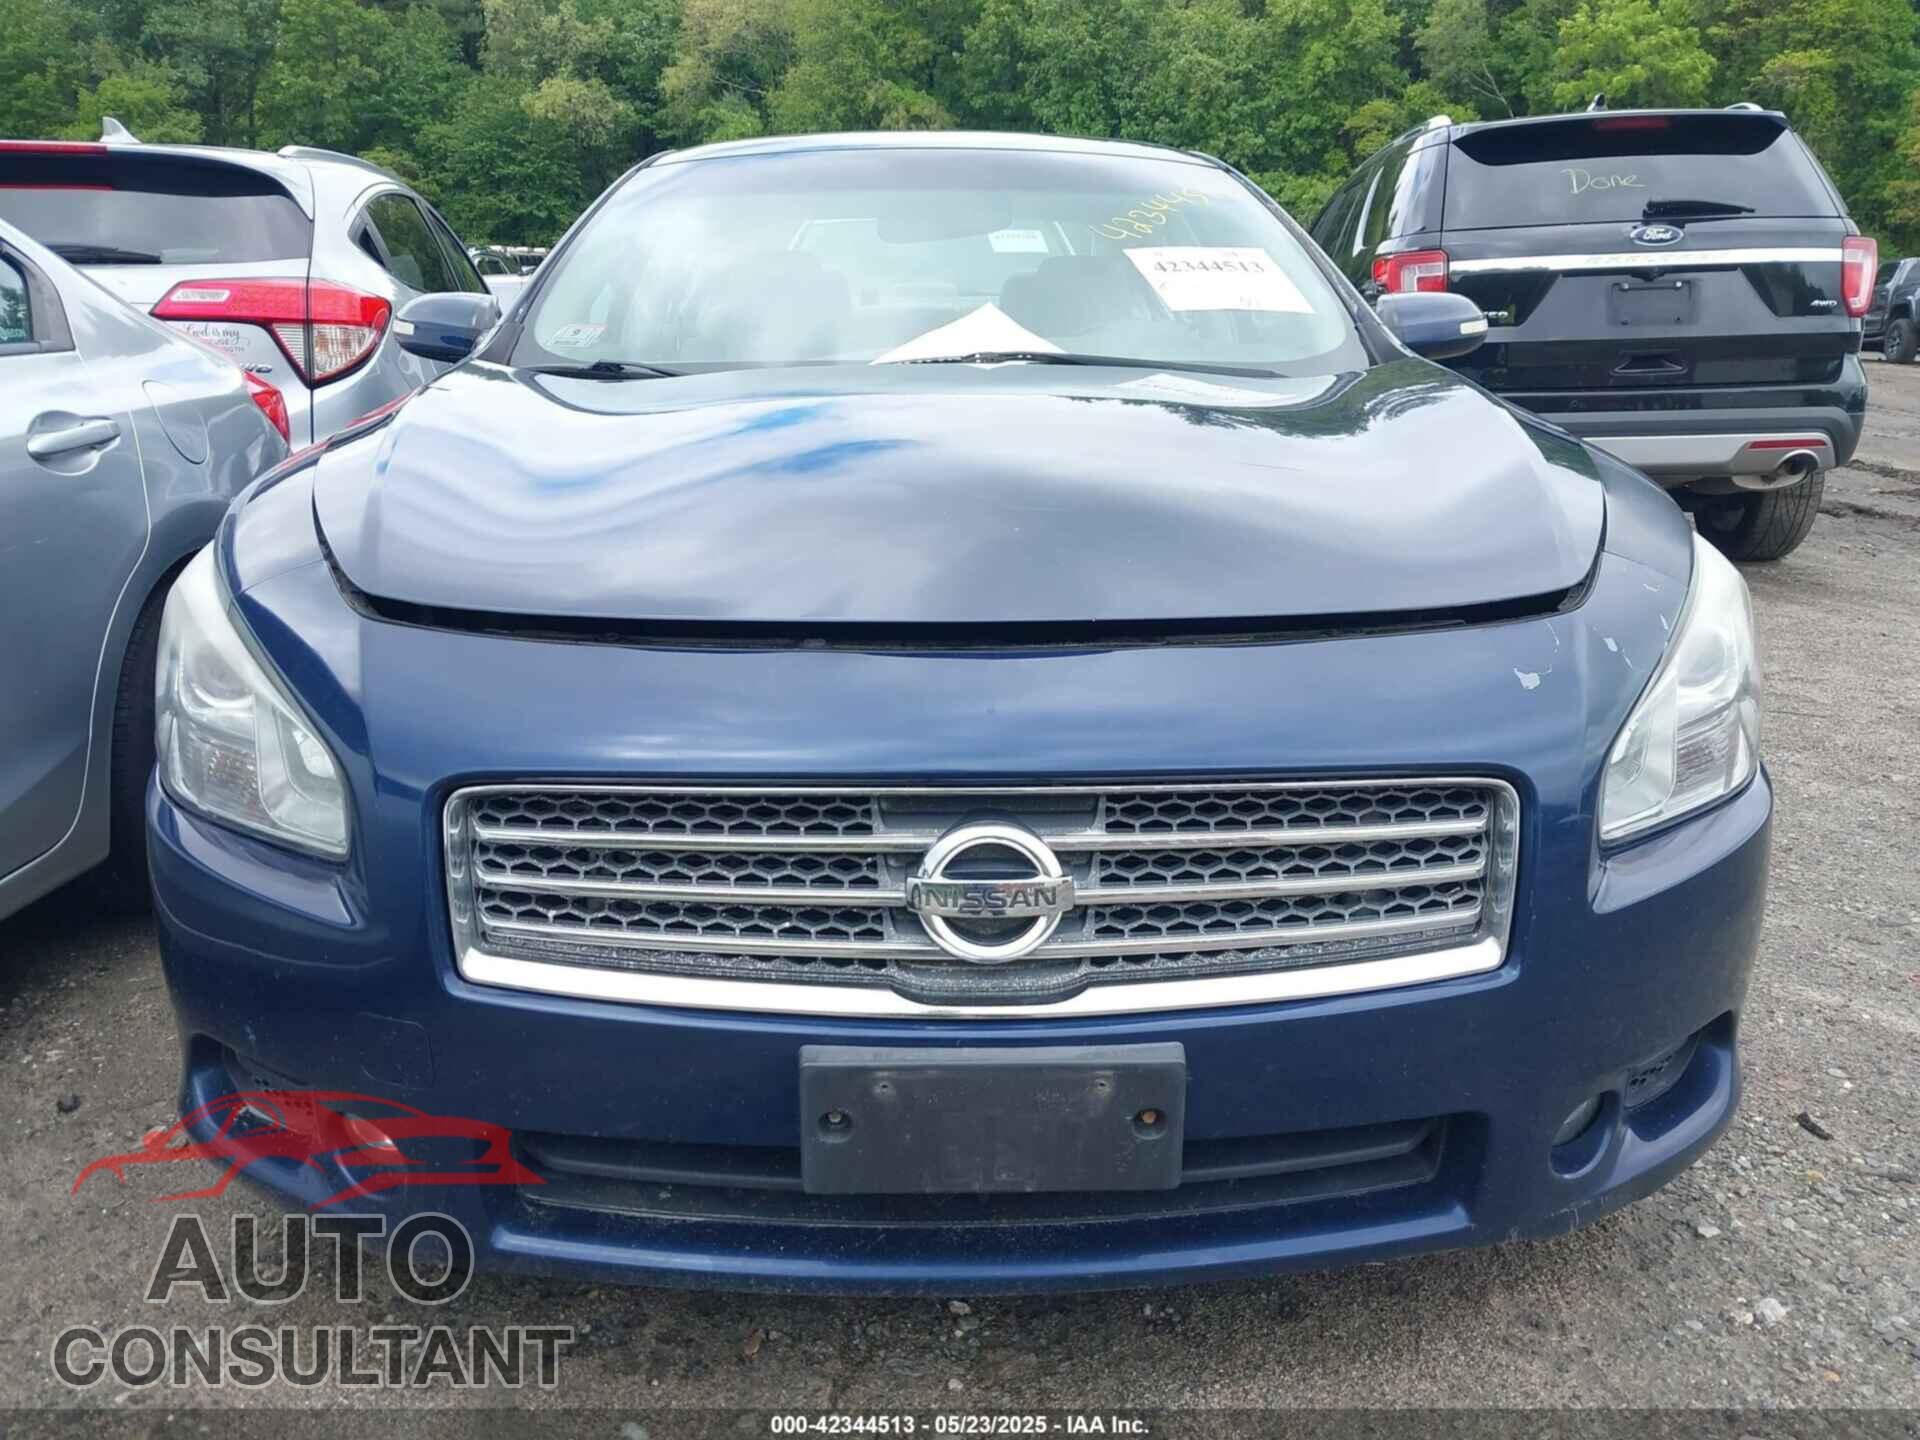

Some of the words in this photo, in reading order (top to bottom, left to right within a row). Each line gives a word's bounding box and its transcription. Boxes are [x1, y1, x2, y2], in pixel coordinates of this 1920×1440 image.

[1560, 167, 1647, 195] Done
[1642, 227, 1673, 241] Ford
[1153, 259, 1266, 273] 42344513
[925, 885, 1058, 911] NISSAN
